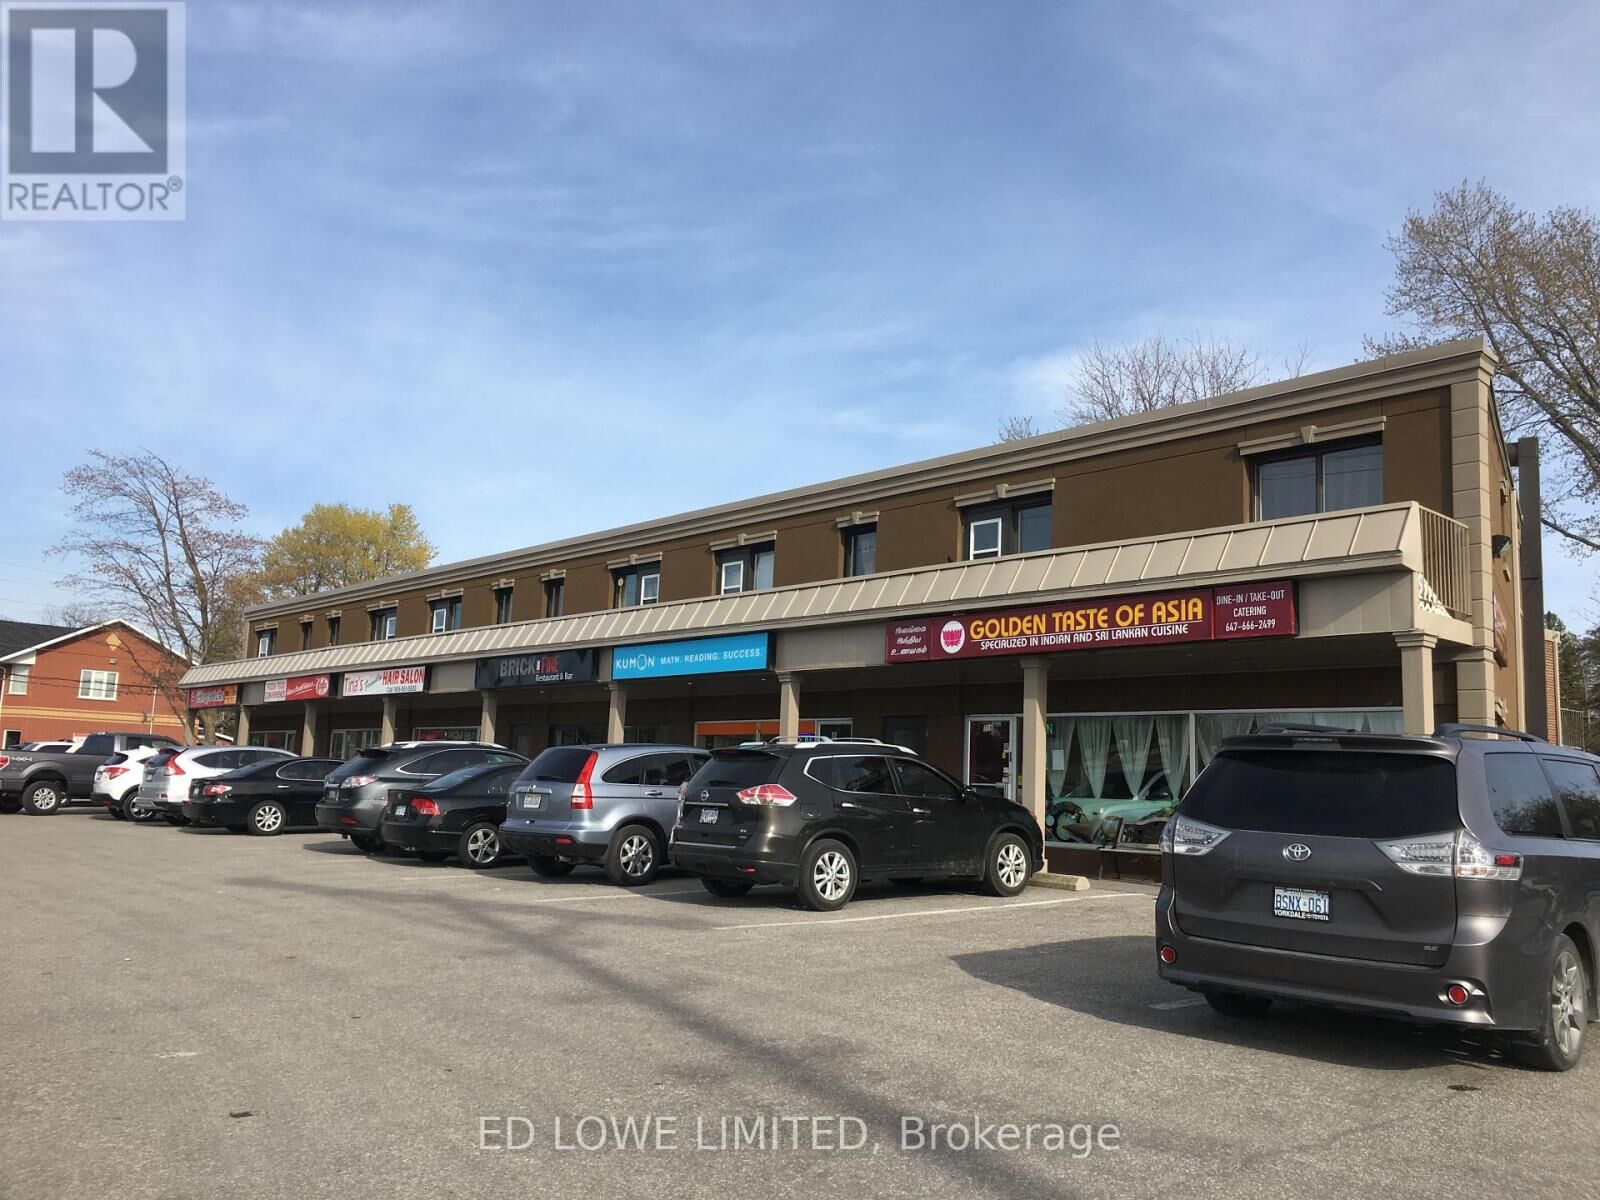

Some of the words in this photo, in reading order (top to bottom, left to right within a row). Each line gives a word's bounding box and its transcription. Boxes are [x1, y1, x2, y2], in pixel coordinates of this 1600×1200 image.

[1216, 593, 1244, 606] DINE-IN
[1249, 590, 1286, 602] TAKE-OUT
[969, 613, 1047, 640] GOLDEN
[1052, 607, 1109, 633] TASTE
[1115, 603, 1145, 627] OF
[1152, 597, 1203, 624] ASIA
[1233, 606, 1267, 617] CATERING
[1225, 619, 1276, 632] 647-666-2499
[980, 638, 1027, 650] SPECIALIZED
[1030, 637, 1039, 647] IN
[1040, 634, 1071, 646] INDIAN
[1073, 632, 1093, 643] AND
[1095, 631, 1109, 641] SRI
[1111, 627, 1149, 640] LANKAN
[1151, 624, 1189, 636] CUISINE
[499, 656, 536, 677] BRICK
[615, 654, 655, 670] KUMON
[382, 670, 400, 686] HAIR
[400, 668, 425, 684] SALON
[535, 674, 560, 682] Restaurant
[564, 672, 574, 680] Bar
[1274, 909, 1306, 919] YORKDALE
